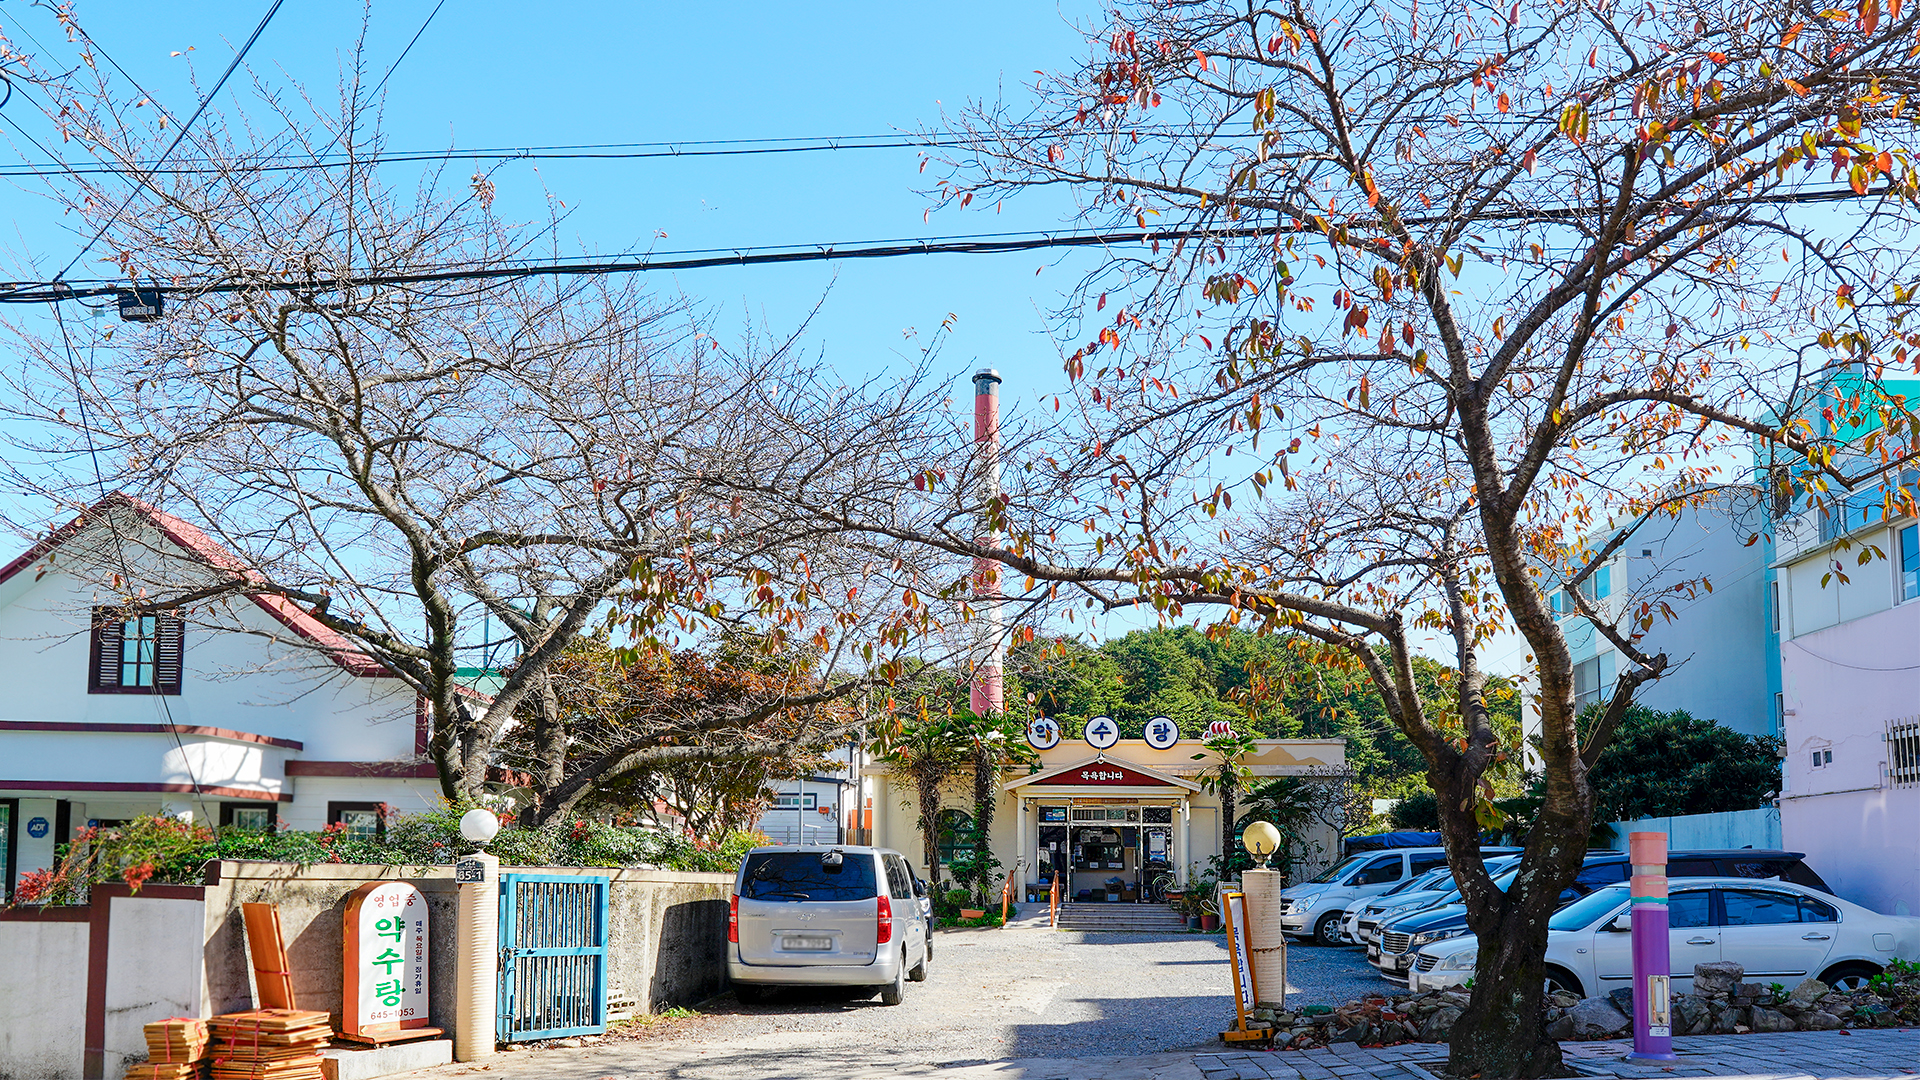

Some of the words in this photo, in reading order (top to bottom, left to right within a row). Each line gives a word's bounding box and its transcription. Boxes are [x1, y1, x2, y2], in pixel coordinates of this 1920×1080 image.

[1081, 770, 1123, 780] 목욕합니다
[31, 823, 45, 831] ADT
[374, 893, 416, 907] 영업중
[415, 920, 423, 933] 매주
[371, 916, 406, 1006] 약수탕
[371, 1007, 415, 1020] 645-1053
